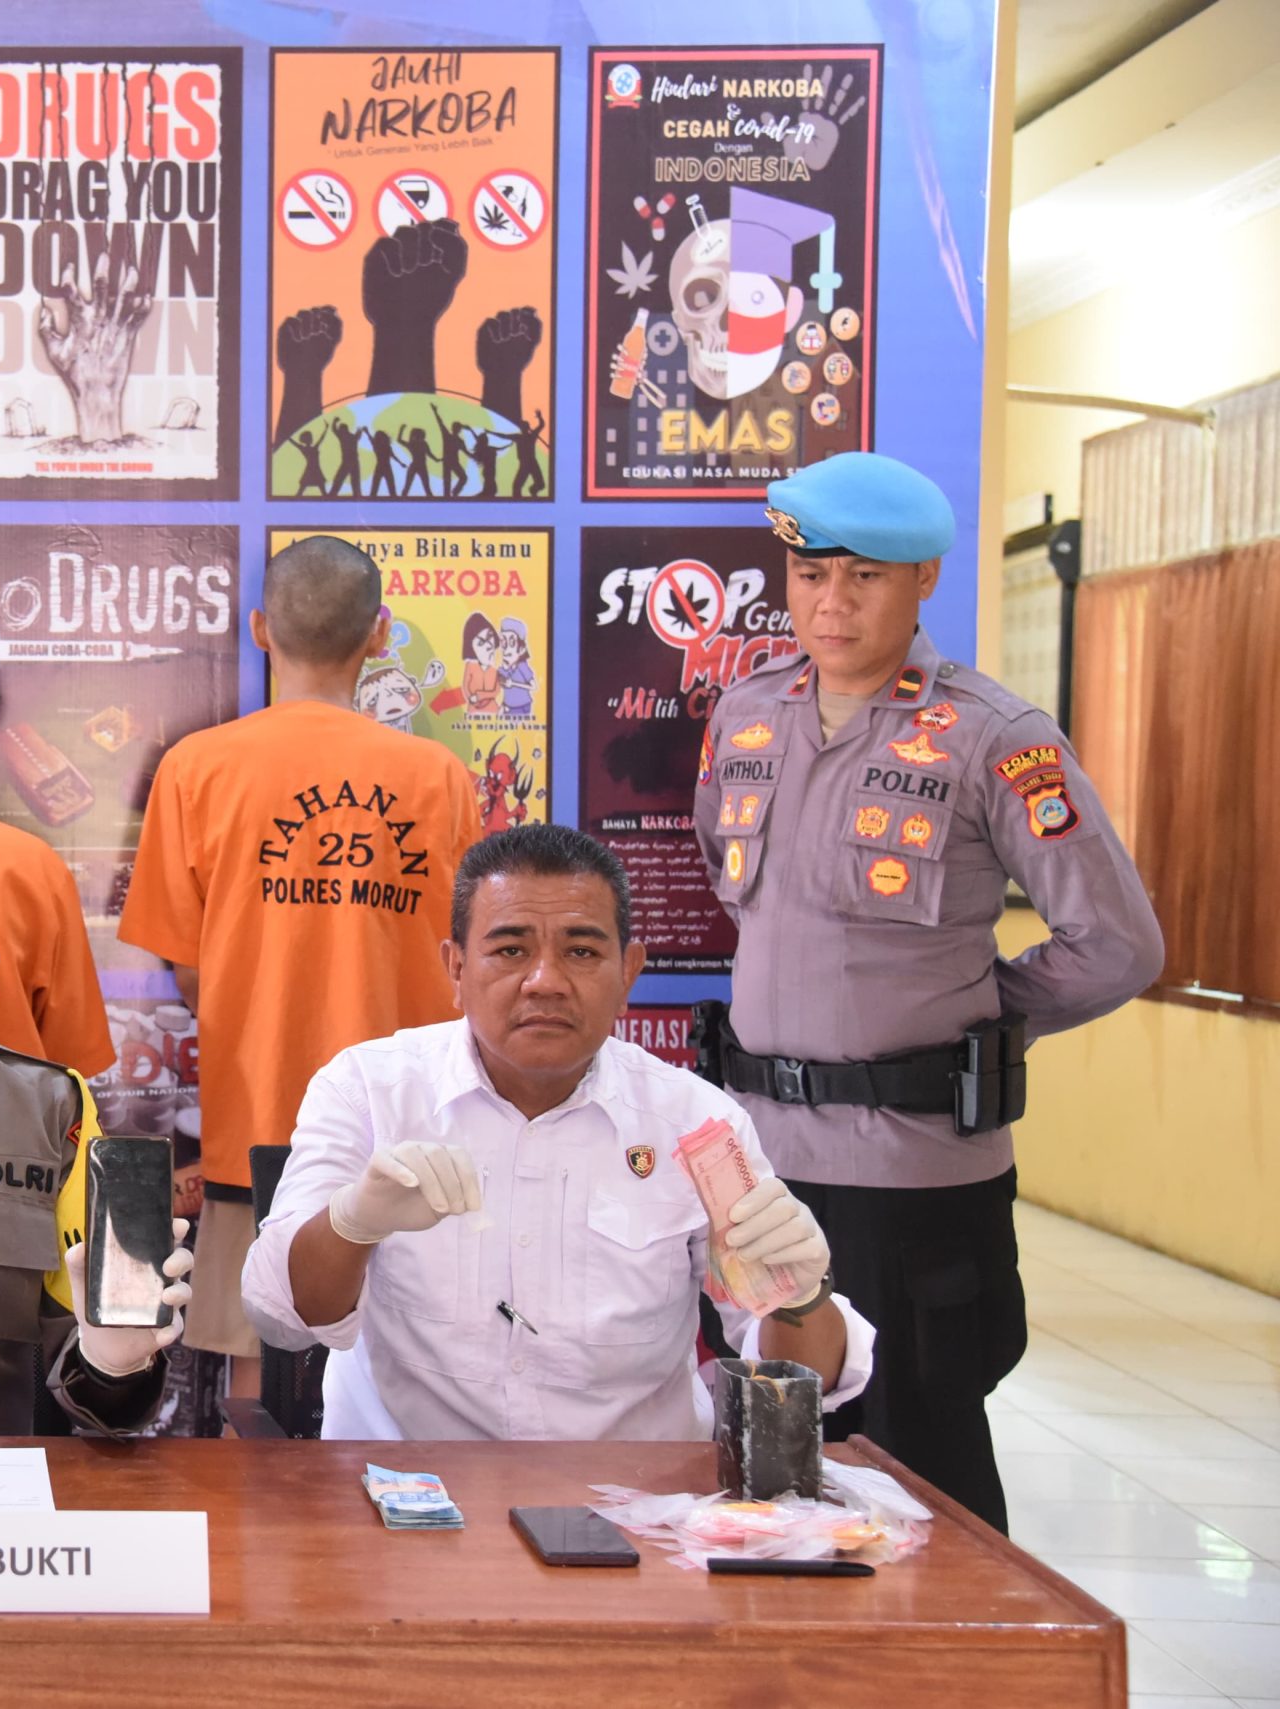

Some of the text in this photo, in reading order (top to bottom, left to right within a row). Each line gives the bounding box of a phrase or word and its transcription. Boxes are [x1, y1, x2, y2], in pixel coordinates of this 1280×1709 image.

[370, 53, 462, 91] JAUHI
[651, 73, 824, 103] Hindari NARKOBA
[320, 86, 516, 145] NARKOBA
[663, 120, 730, 138] CEGAH
[334, 137, 494, 159] Untuk Generasi Yang Lebih Baik
[714, 143, 753, 154] Dengan
[655, 156, 811, 181] INDONESIA
[120, 161, 217, 222] YOU
[660, 409, 796, 454] EMAS
[623, 467, 687, 479] EDUKASI
[692, 467, 733, 478] MASA
[739, 467, 779, 478] MUDA
[415, 538, 460, 558] Bila
[471, 538, 532, 558] kamu
[381, 570, 527, 597] ARKOBA
[8, 644, 115, 656] JANGAN COBA-COBA
[863, 767, 951, 802] POLRI
[259, 779, 428, 877] TAHANAN
[602, 818, 637, 830] BAHAYA
[317, 832, 374, 867] 25
[262, 877, 422, 915] POLRES MORUT
[614, 1019, 688, 1048] NERASI
